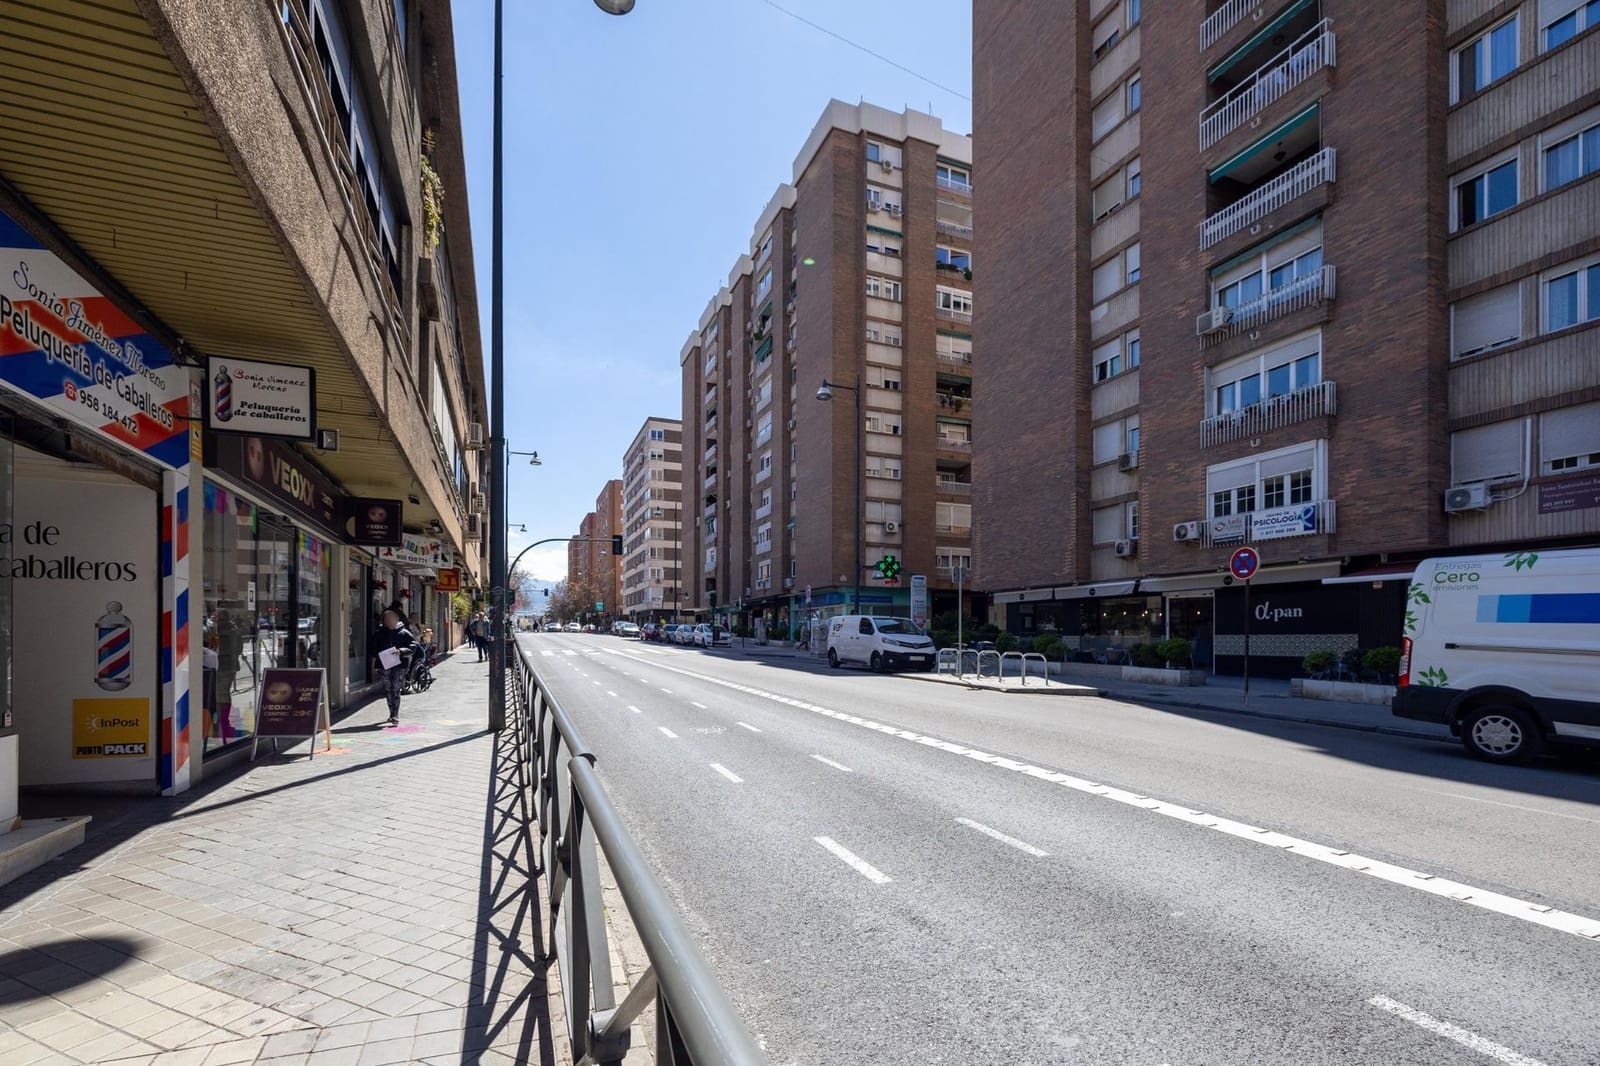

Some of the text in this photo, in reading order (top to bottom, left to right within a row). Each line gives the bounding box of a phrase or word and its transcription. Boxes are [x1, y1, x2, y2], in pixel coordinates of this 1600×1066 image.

[13, 261, 167, 391] Sonia Jiménez Moreno
[0, 294, 92, 377] Peluquería
[95, 361, 113, 391] de
[116, 375, 174, 429] Caballeros
[80, 389, 138, 433] 958 184 472
[234, 409, 306, 423] de caballeros
[270, 451, 315, 510] VEOXX
[24, 521, 60, 546] de
[0, 554, 137, 582] caballeros
[1434, 571, 1480, 583] Cero
[101, 717, 140, 728] InPost
[104, 743, 145, 755] PACK
